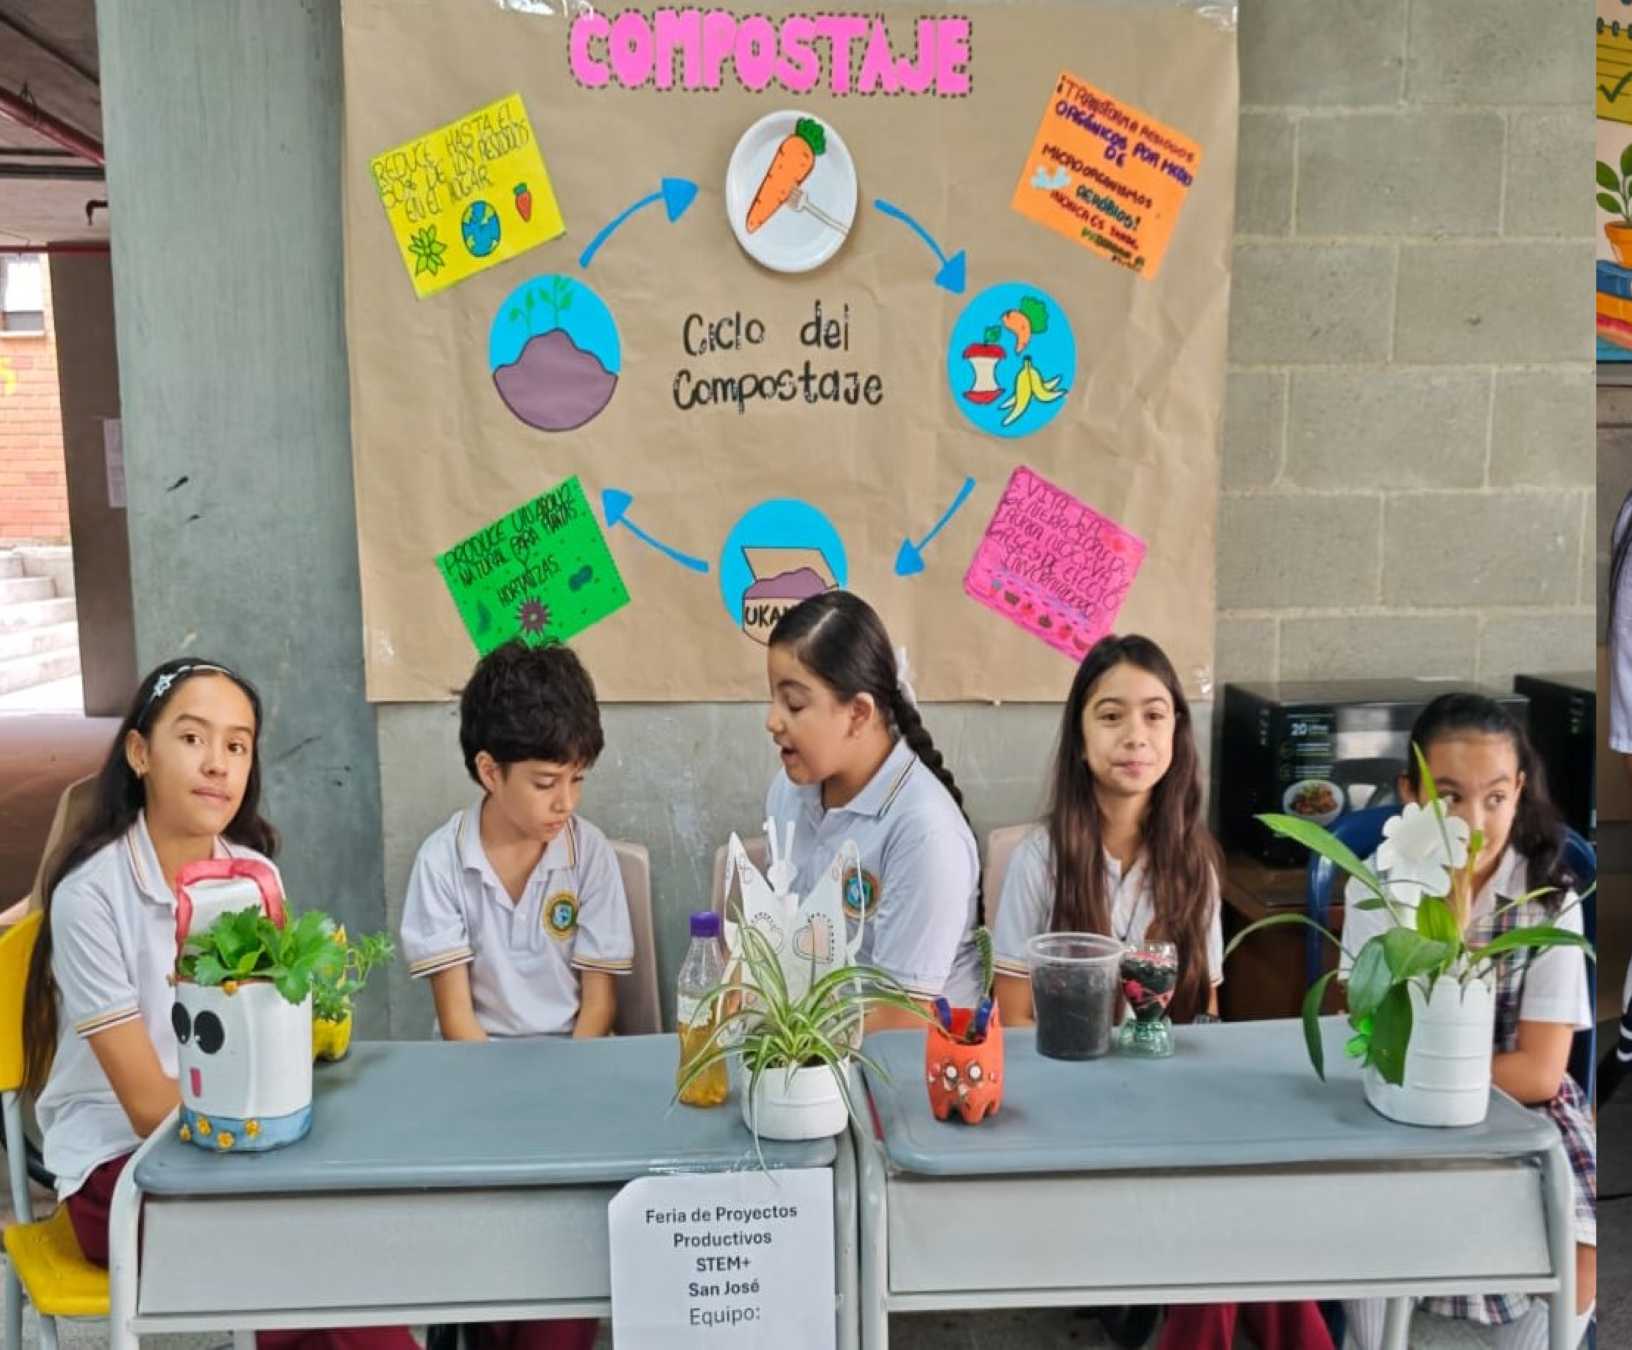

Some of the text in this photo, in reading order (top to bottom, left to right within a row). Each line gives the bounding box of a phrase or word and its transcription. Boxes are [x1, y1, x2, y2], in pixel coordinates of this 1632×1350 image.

[568, 6, 972, 97] COMPOSTAJE
[445, 114, 492, 154] HASTA
[1104, 145, 1126, 168] DE
[1133, 142, 1160, 168] POR
[683, 311, 765, 356] Ciclo
[673, 360, 884, 415] Compostaje
[645, 1204, 798, 1225] Feria de Proyectos
[673, 1231, 773, 1249] Productivos
[696, 1256, 752, 1272] STEM+
[688, 1278, 760, 1298] San José
[689, 1306, 761, 1328] Equipo:
